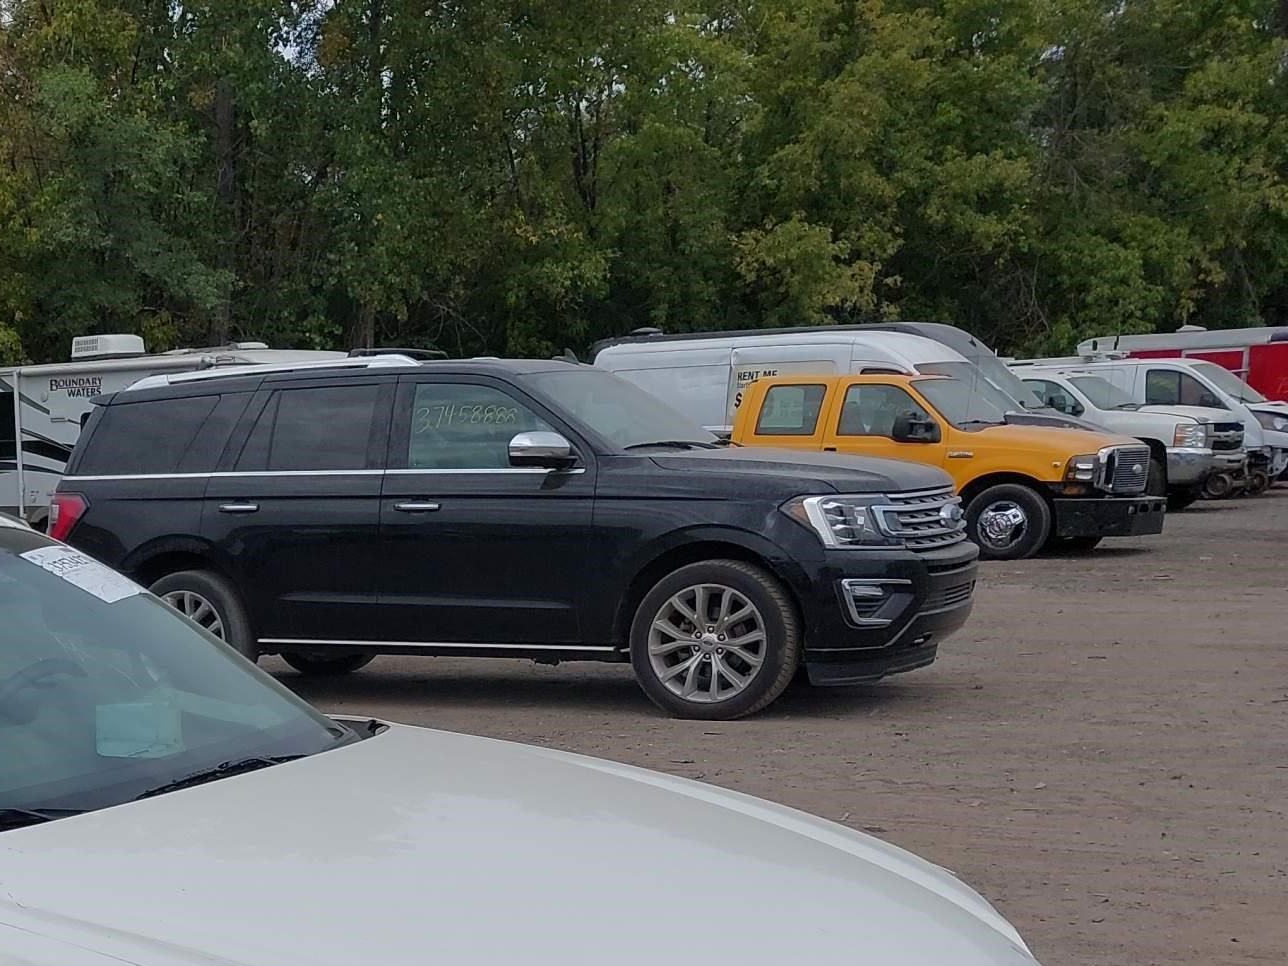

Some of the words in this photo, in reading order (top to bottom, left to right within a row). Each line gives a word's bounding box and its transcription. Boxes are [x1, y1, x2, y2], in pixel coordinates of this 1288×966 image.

[737, 370, 760, 381] RENT
[49, 376, 103, 392] BOUNDARY
[67, 387, 102, 398] WATERS
